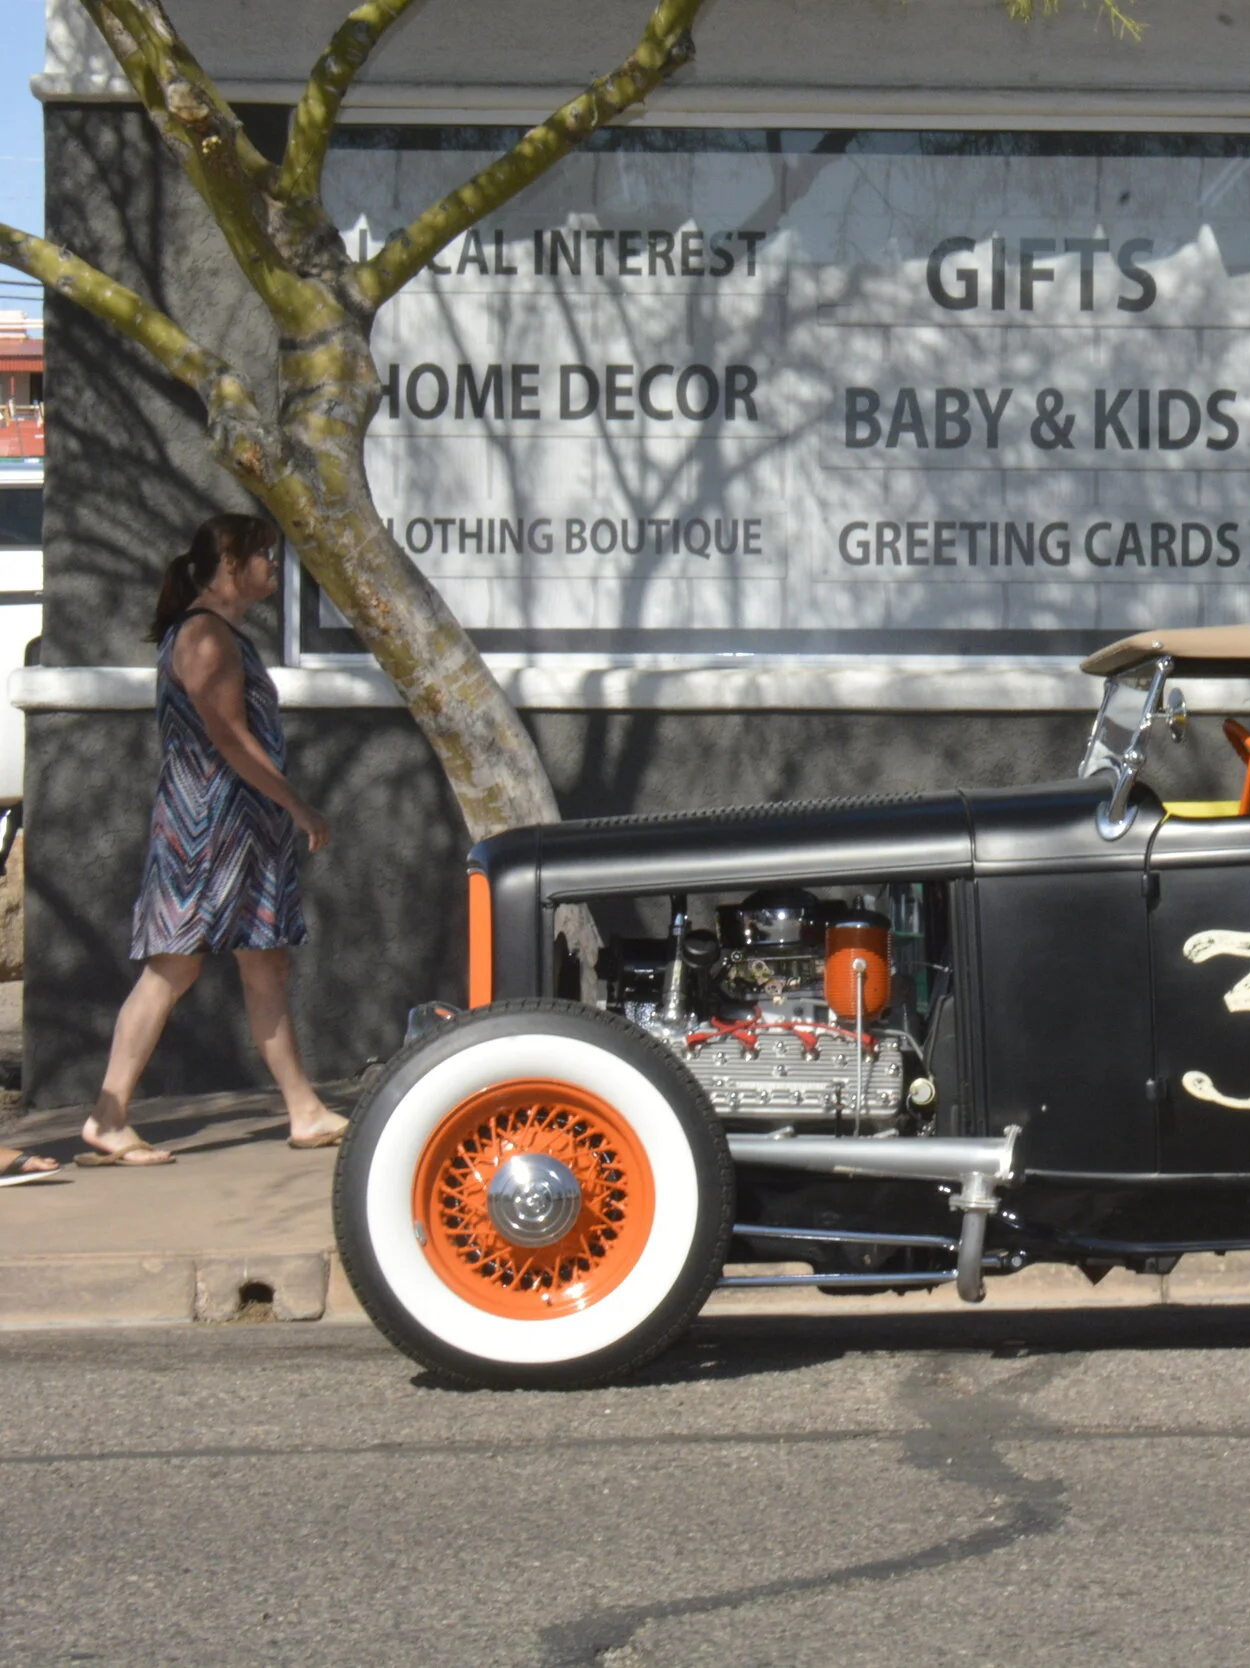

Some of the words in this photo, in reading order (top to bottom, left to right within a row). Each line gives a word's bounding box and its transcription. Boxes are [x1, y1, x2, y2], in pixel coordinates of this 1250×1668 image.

[358, 228, 518, 275] LAL
[533, 229, 766, 277] INTEREST
[926, 235, 1158, 312] GIFTS
[559, 363, 758, 421] DECOR
[844, 386, 1014, 449] BABY
[1029, 387, 1076, 450] &
[1093, 388, 1240, 451] KIDS
[565, 517, 762, 560] BOUTIQUE
[838, 521, 1071, 567] GREETING
[1084, 522, 1241, 568] CARDS
